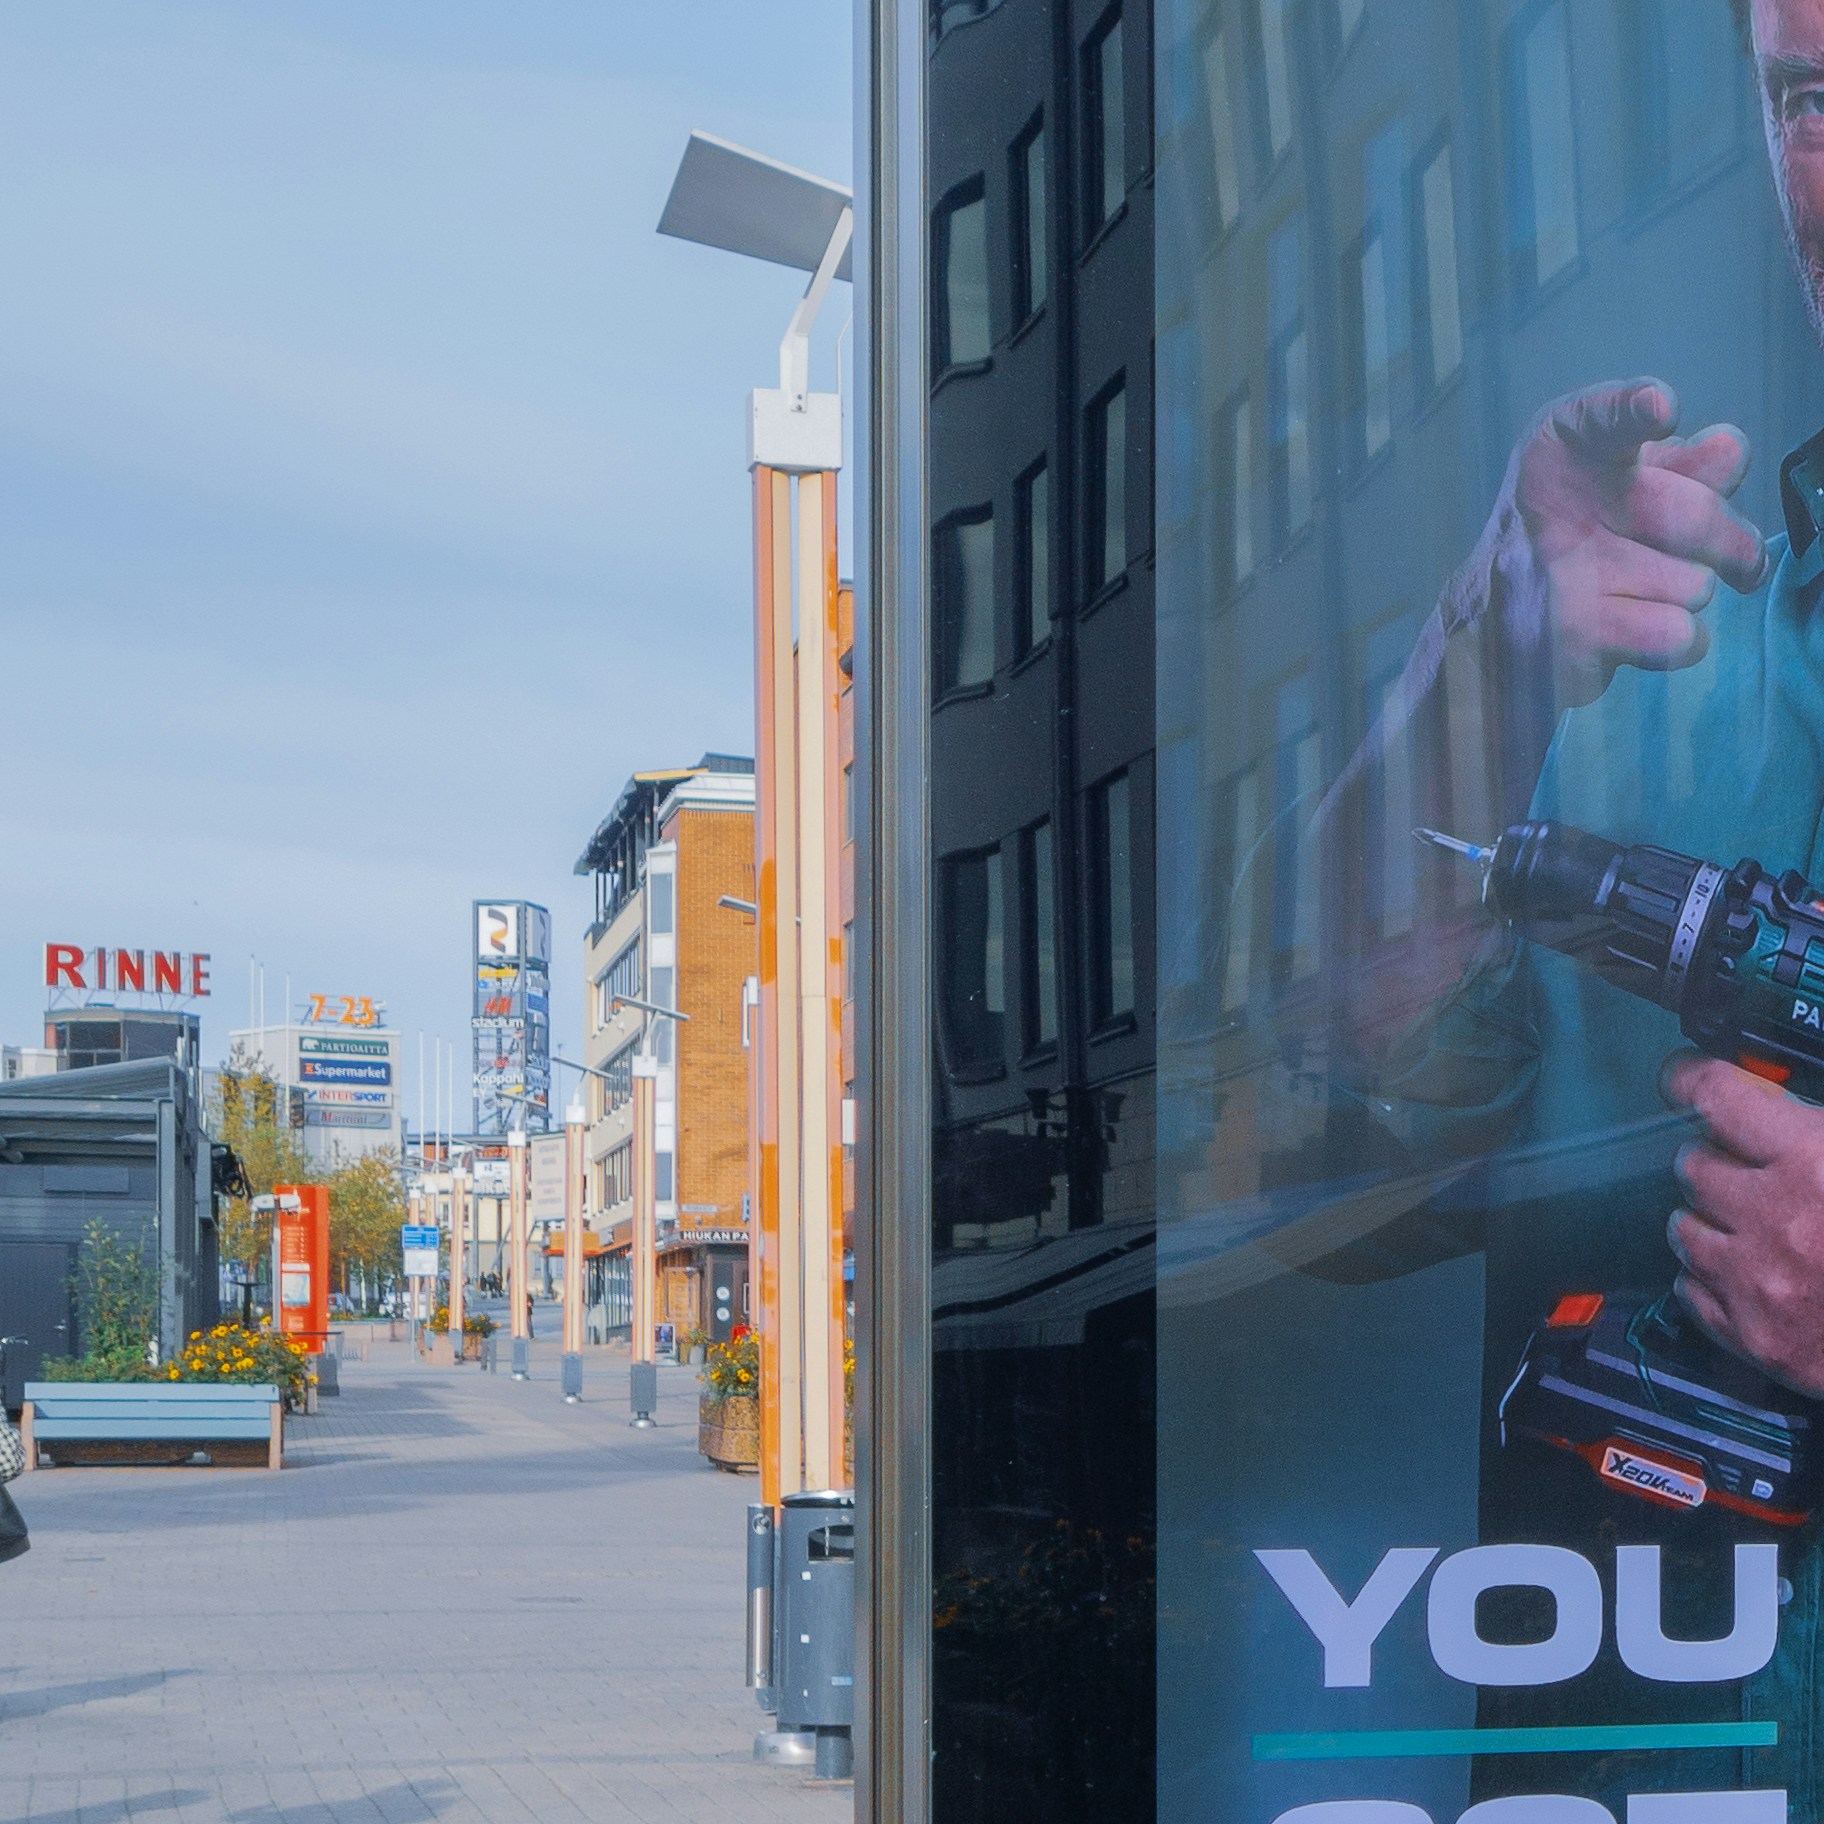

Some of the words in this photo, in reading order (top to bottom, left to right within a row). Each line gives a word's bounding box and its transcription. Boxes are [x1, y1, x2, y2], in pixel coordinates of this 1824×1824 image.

[43, 942, 211, 996] RINNE
[309, 993, 375, 1025] 7-23
[320, 1041, 388, 1055] PARTIOAITTA
[319, 1090, 387, 1102] INTERSPORT
[1252, 1543, 1779, 1689] YOU
